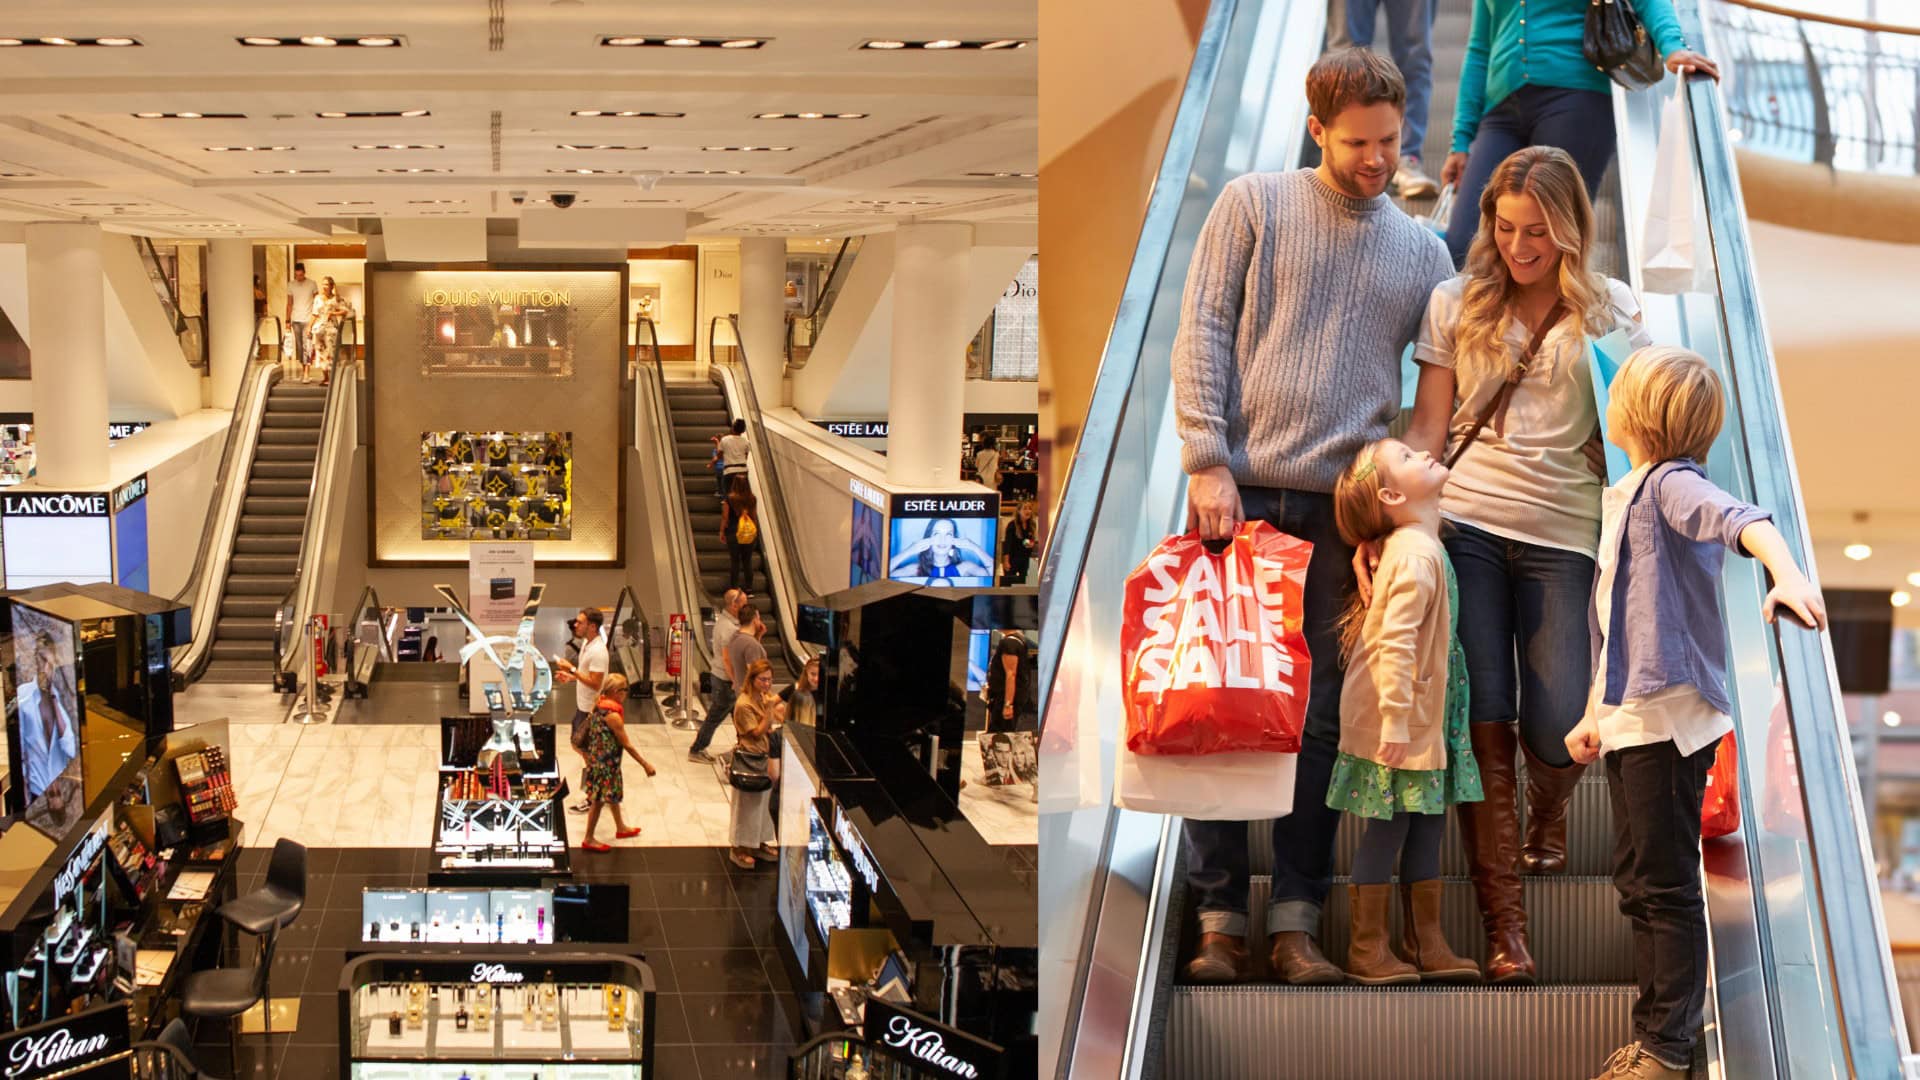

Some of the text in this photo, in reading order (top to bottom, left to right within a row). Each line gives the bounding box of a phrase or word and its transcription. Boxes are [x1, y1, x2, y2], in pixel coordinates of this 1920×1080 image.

[423, 289, 571, 307] LOUIS VUITTON
[1003, 279, 1037, 297] Dio
[865, 424, 889, 436] LAU
[4, 493, 106, 514] LANCÔME
[939, 500, 986, 512] LAUDER
[1143, 552, 1285, 606] SALE
[1142, 598, 1288, 652] SALE
[1136, 643, 1295, 698] SALE
[4, 1028, 109, 1077] Kilian
[883, 1015, 978, 1079] Kilian
